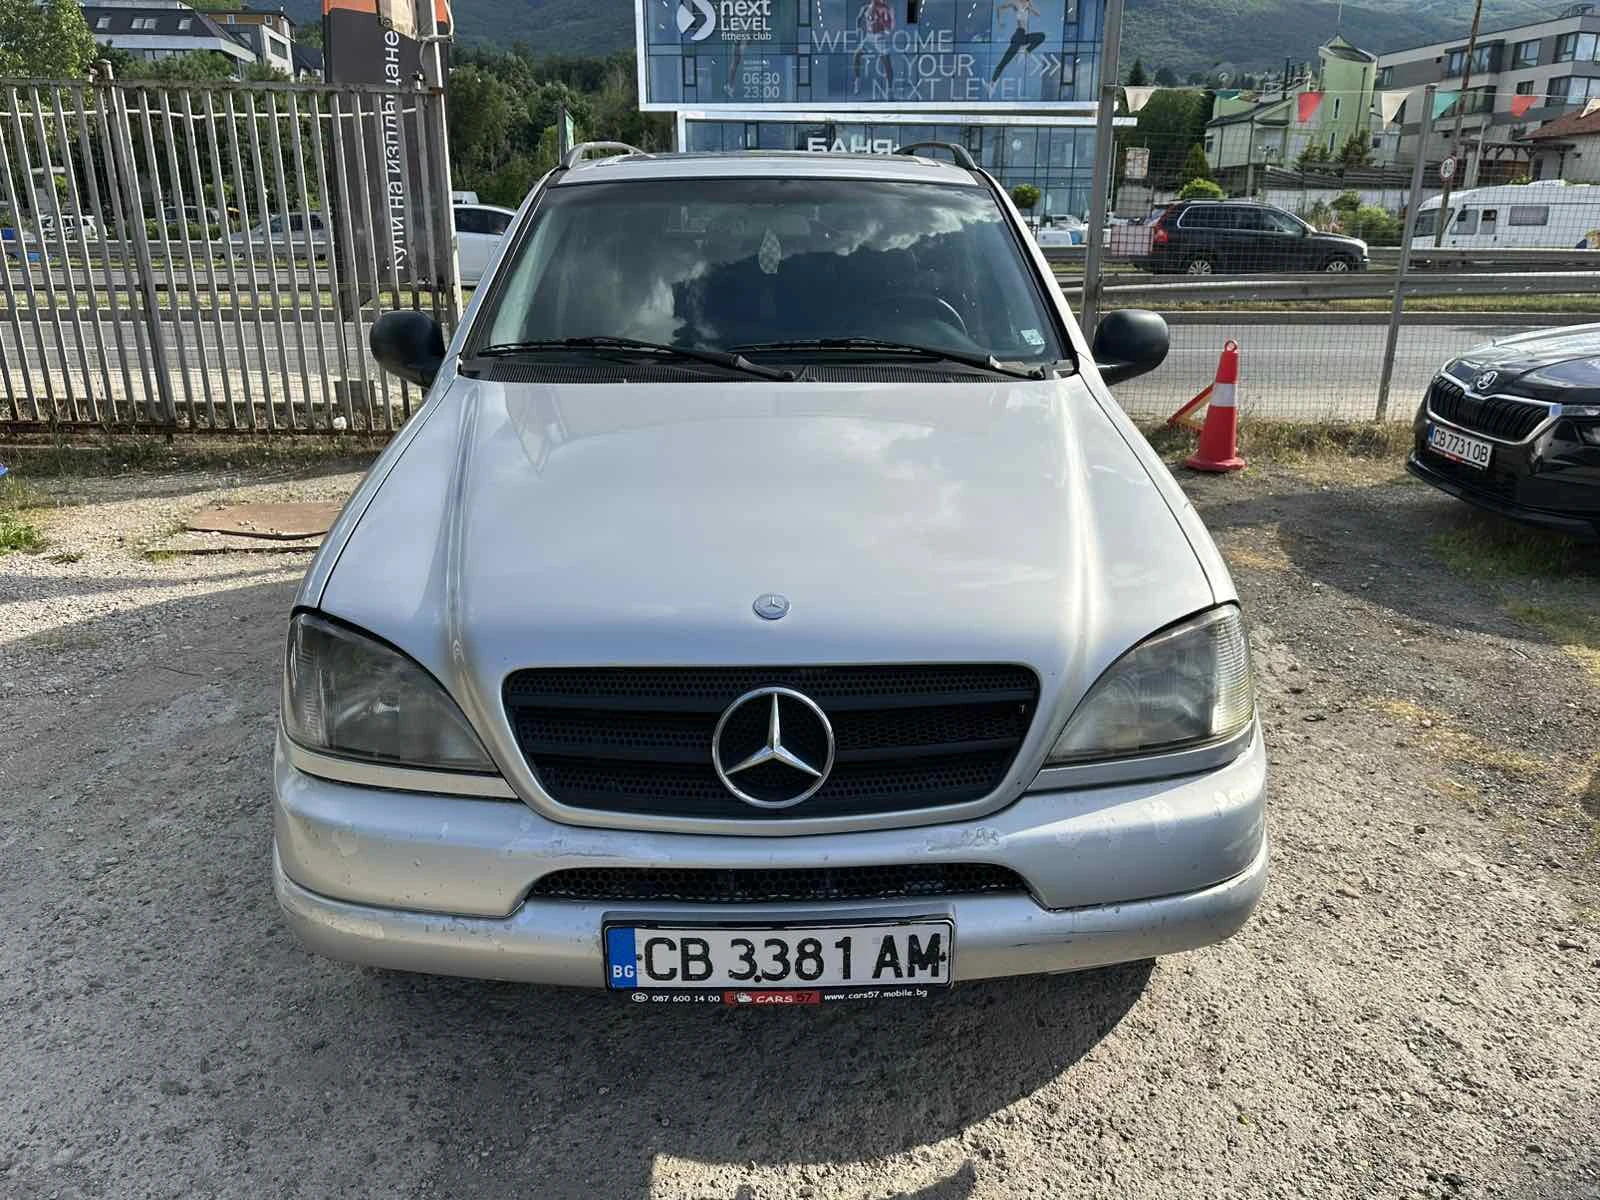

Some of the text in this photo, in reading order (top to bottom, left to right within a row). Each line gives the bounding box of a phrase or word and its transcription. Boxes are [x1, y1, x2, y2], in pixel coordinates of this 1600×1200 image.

[721, 0, 771, 16] next
[721, 17, 772, 31] LEVEL
[721, 32, 772, 41] fitness club
[811, 30, 953, 52] WELCOME
[904, 54, 976, 77] YOUR
[743, 72, 780, 85] 06:30
[743, 86, 780, 98] 23:00
[872, 78, 1029, 100] NEXT LEVEL
[644, 933, 942, 981] CB 3381 AM
[612, 964, 635, 978] BG
[652, 995, 669, 1003] 087
[672, 995, 691, 1003] 600
[708, 994, 721, 1002] 00
[824, 988, 928, 1001] www.cars57.mobile.bg
